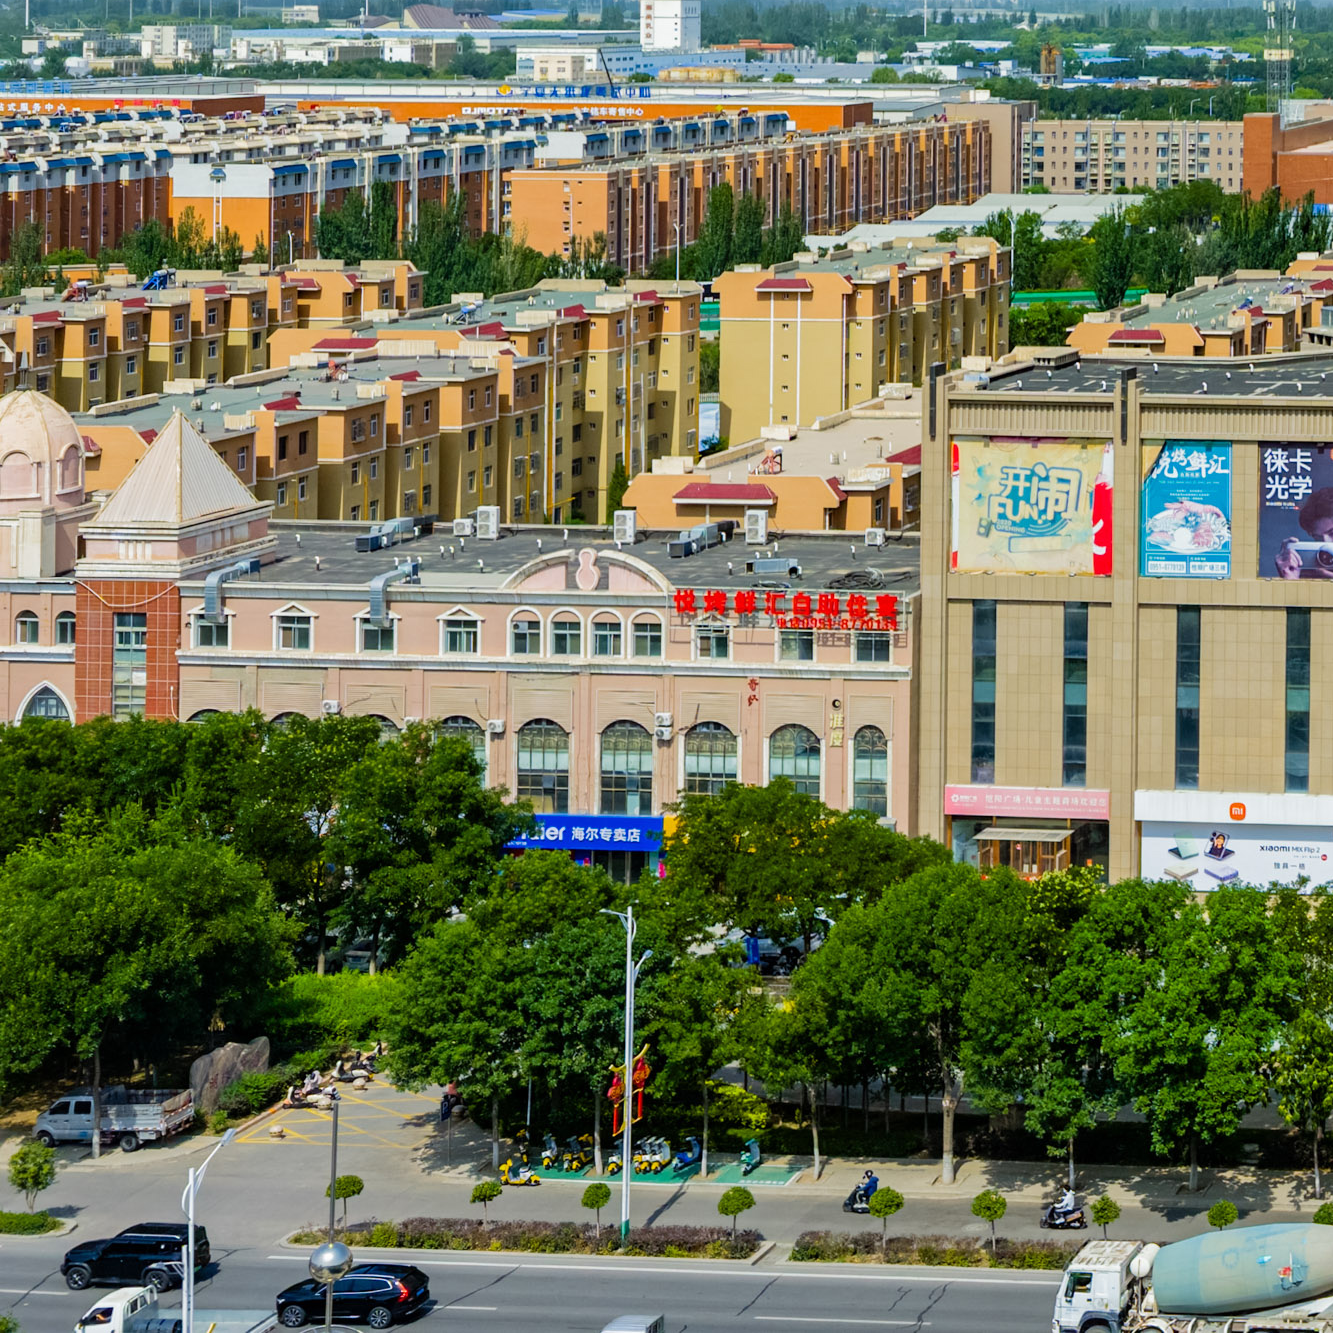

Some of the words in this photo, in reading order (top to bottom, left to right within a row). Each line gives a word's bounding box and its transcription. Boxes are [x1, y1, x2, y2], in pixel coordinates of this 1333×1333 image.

[1264, 448, 1313, 473] 徕卡
[1265, 475, 1312, 500] 光学
[571, 826, 641, 843] 海尔专卖店
[1304, 846, 1315, 854] Flip
[1316, 846, 1321, 854] 2
